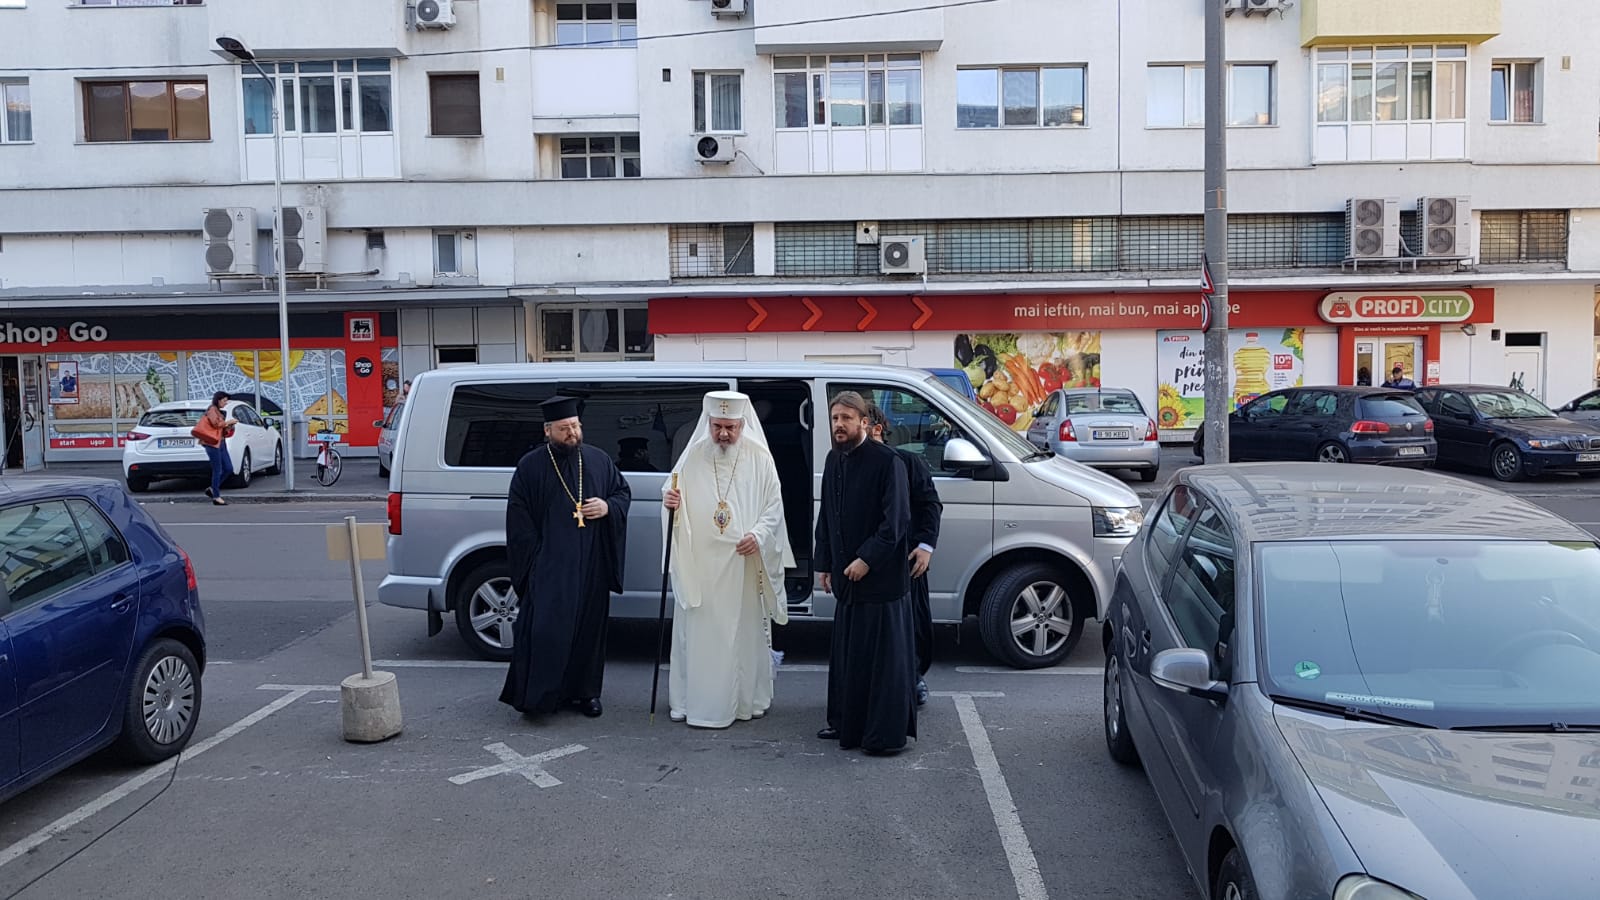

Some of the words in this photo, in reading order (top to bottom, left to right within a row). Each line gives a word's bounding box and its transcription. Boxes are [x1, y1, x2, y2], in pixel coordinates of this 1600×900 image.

[1014, 305, 1040, 317] mai
[1044, 303, 1085, 318] ieftin,
[1089, 304, 1115, 316] mai
[1119, 302, 1150, 317] bun,
[1153, 302, 1179, 315] mai
[1361, 299, 1418, 315] PROFI
[1428, 299, 1463, 314] CITY
[1179, 346, 1196, 359] din
